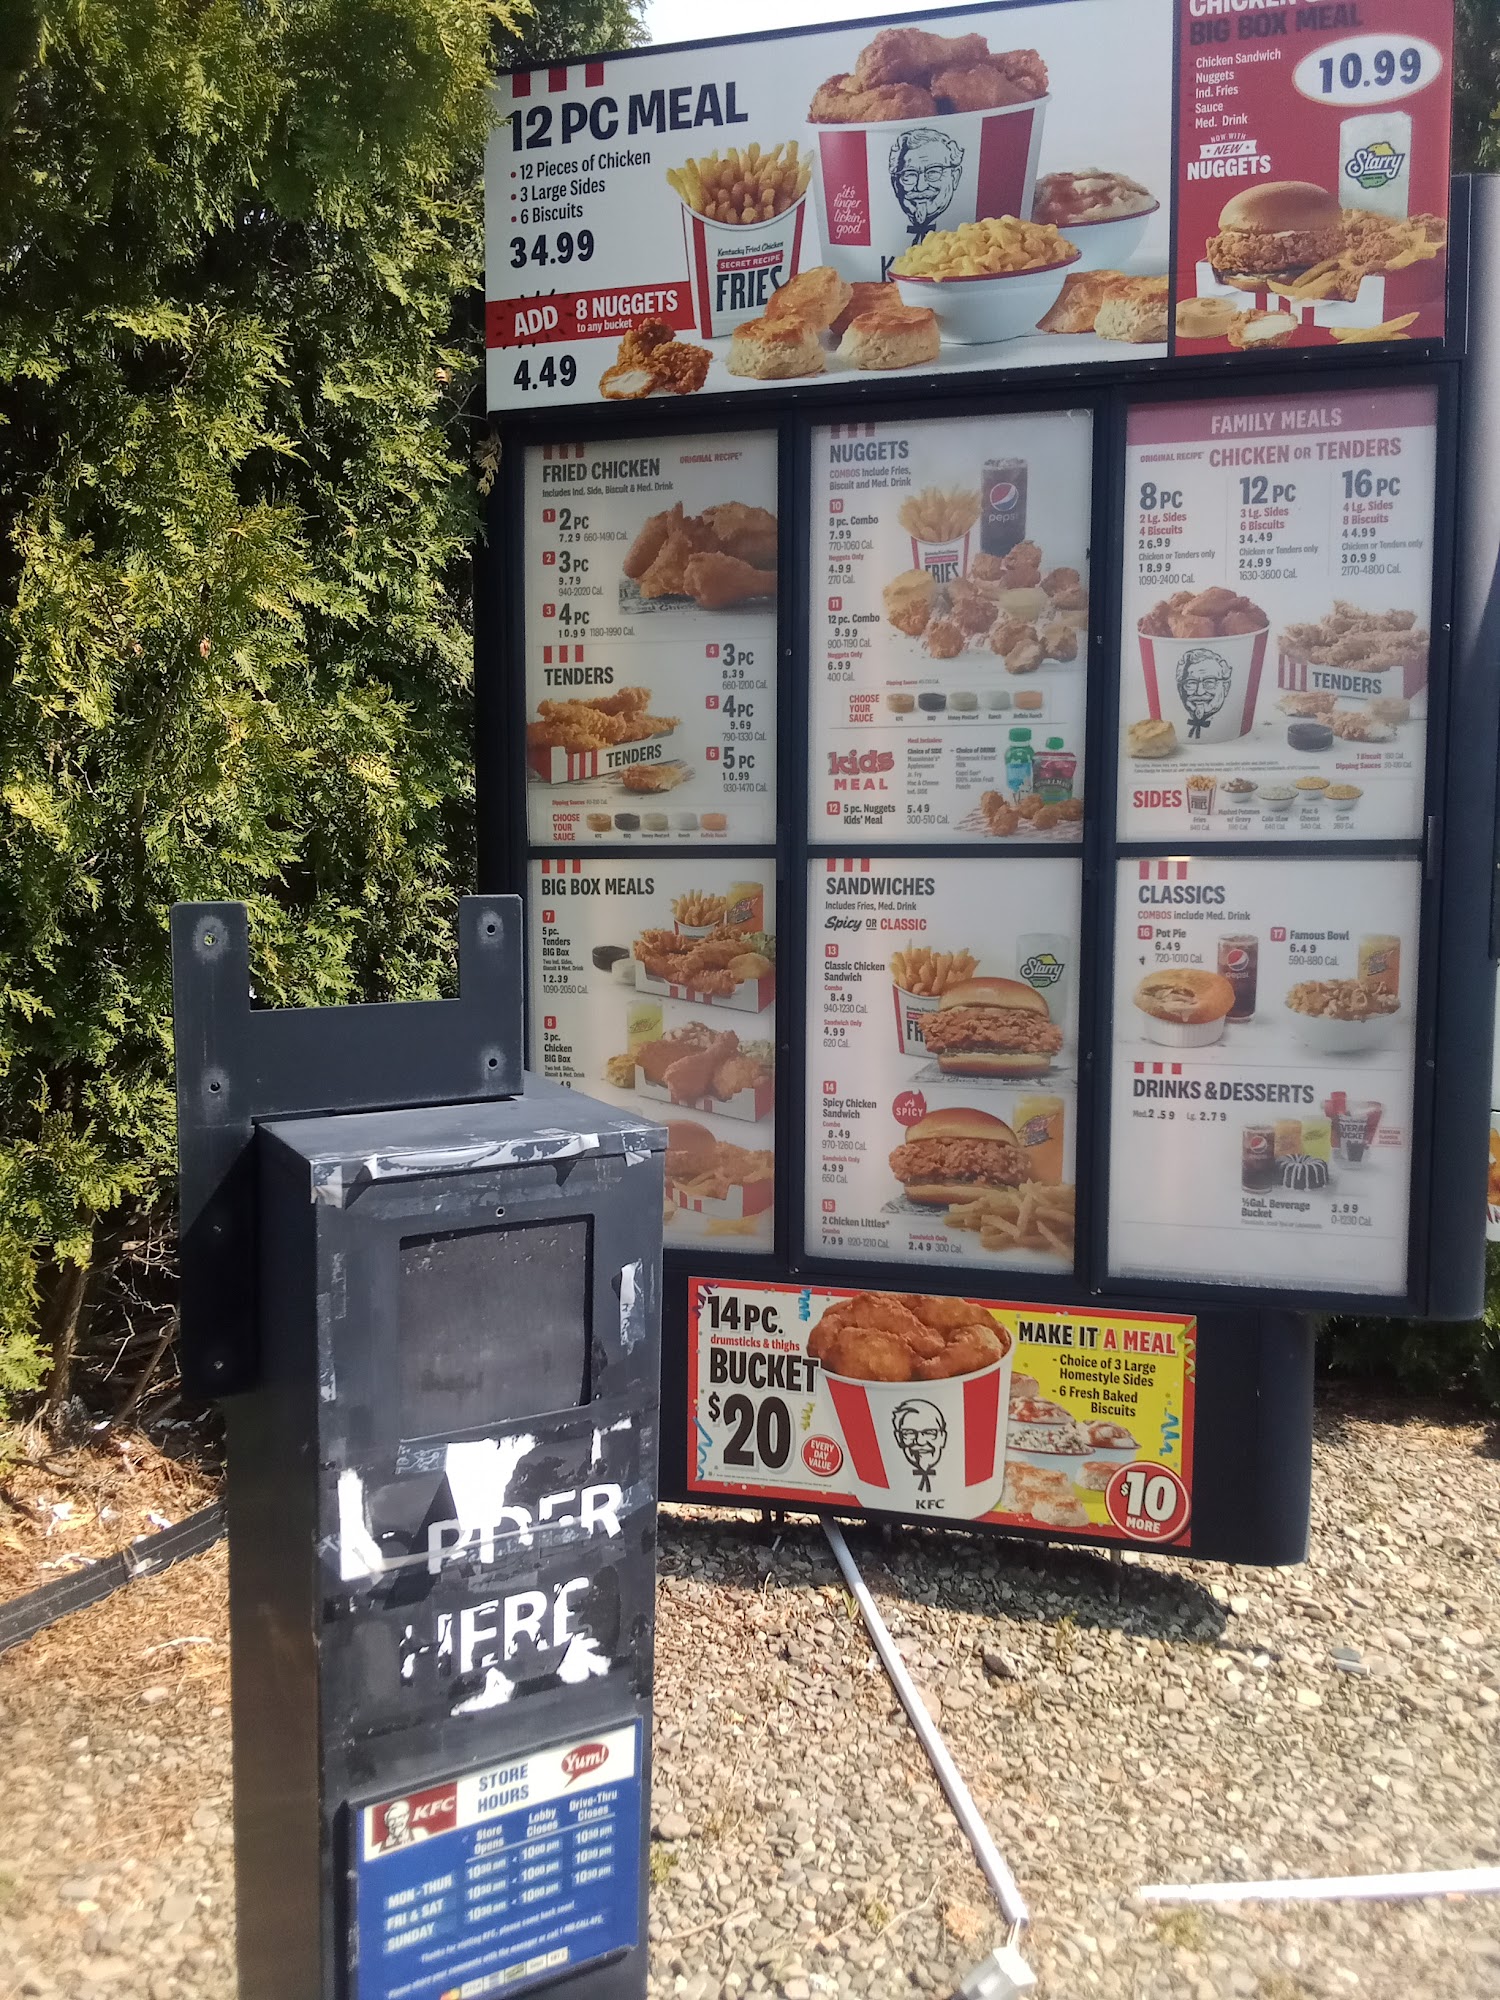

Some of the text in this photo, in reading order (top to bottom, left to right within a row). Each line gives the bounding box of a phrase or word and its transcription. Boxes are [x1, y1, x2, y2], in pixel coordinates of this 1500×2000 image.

[1196, 49, 1281, 69] Chicken Sandwich
[1196, 70, 1234, 85] Nuggets
[1319, 48, 1421, 93] 10.99
[1195, 85, 1238, 99] Ind. Fries
[511, 82, 748, 152] 12 PC MEAL
[1195, 102, 1223, 114] Sauce
[1195, 114, 1247, 129] Med. Drink
[1211, 132, 1246, 143] NOW WITH
[520, 150, 651, 182] 12 Pieces of Chicken
[1188, 155, 1271, 180] NUGGETS
[520, 177, 606, 205] 3 Large Sides
[521, 203, 584, 225] 6 Biscuits
[836, 225, 861, 240] good
[510, 229, 595, 269] 34.99
[576, 290, 679, 321] 8 NUGGETS
[514, 305, 559, 338] ADD
[577, 317, 633, 335] to any bucket
[513, 354, 577, 392] 4.49
[1211, 408, 1343, 434] FAMILY MEALS
[829, 441, 909, 464] NUGGETS
[1210, 437, 1402, 467] CHICKEN OR TENDERS
[543, 458, 661, 483] FRIED CHICKEN
[1240, 476, 1296, 505] 12 PC
[1342, 469, 1401, 498] 16 PC
[1140, 482, 1183, 510] 8 PC
[559, 508, 590, 530] 2 PC
[1139, 538, 1171, 549] 26.99
[559, 551, 589, 574] 3 PC
[1239, 570, 1281, 581] 1630-3600
[559, 604, 590, 625] 4 PC
[723, 643, 755, 667] 3 PC
[544, 667, 614, 686] TENDERS
[1312, 671, 1382, 695] TENDERS
[722, 695, 754, 718] 4 PC
[849, 694, 880, 704] CHOOSE
[849, 705, 871, 713] YOUR
[849, 714, 874, 723] SAUCE
[606, 744, 662, 768] TENDERS
[723, 746, 755, 769] 5 PC
[827, 750, 895, 776] kids
[834, 778, 889, 791] MEAL
[1133, 790, 1182, 809] SIDES
[552, 813, 580, 822] CHOOSE
[553, 823, 573, 832] YOUR
[553, 832, 575, 841] SAUCE
[541, 878, 655, 896] BIG BOX MEALS
[826, 878, 936, 896] SANDWICHES
[1138, 885, 1226, 905] CLASSICS
[825, 901, 917, 912] Includes Fries, Med. Drink
[1138, 910, 1250, 922] COMBOS include Med. Drink
[824, 915, 927, 932] Spicy OR CLASSIC
[542, 938, 571, 946] Tenders
[824, 961, 886, 971] Classic Chicken
[824, 972, 862, 982] Sandwich
[544, 1044, 573, 1053] Chicken
[1133, 1079, 1315, 1103] DRINKS & DESSERTS
[823, 1097, 877, 1109] Spicy Chicken
[896, 1107, 923, 1118] SPICY
[823, 1109, 860, 1119] Sandwich
[1242, 1209, 1273, 1219] Bucket
[708, 1296, 784, 1334] 14 PC.
[711, 1333, 800, 1352] drumsticks & thighs
[1020, 1321, 1176, 1355] MAKE IT A MEAL
[710, 1347, 819, 1393] BUCKET
[1060, 1354, 1156, 1375] Choice of 3 Large
[1060, 1368, 1154, 1387] Homestyle Sides
[1060, 1386, 1138, 1404] 6 Fresh Baked
[1091, 1402, 1136, 1418] Biscuits
[708, 1392, 791, 1469] $20
[810, 1439, 834, 1453] EVERY
[814, 1450, 829, 1460] DAY
[808, 1457, 832, 1471] VALUE
[916, 1499, 945, 1510] KFC
[1121, 1471, 1177, 1521] $10
[1126, 1516, 1161, 1533] MORE
[565, 1746, 608, 1772] Yum!
[479, 1762, 529, 1791] STORE
[414, 1796, 456, 1821] KFC
[478, 1785, 529, 1814] HOURS
[569, 1790, 618, 1812] Drive-Thru
[528, 1809, 556, 1823] Lobby
[577, 1804, 609, 1821] Closes
[477, 1826, 502, 1841] Store
[526, 1820, 558, 1837] Closes
[474, 1839, 504, 1855] Opens
[387, 1923, 436, 1951] SUNDAY
